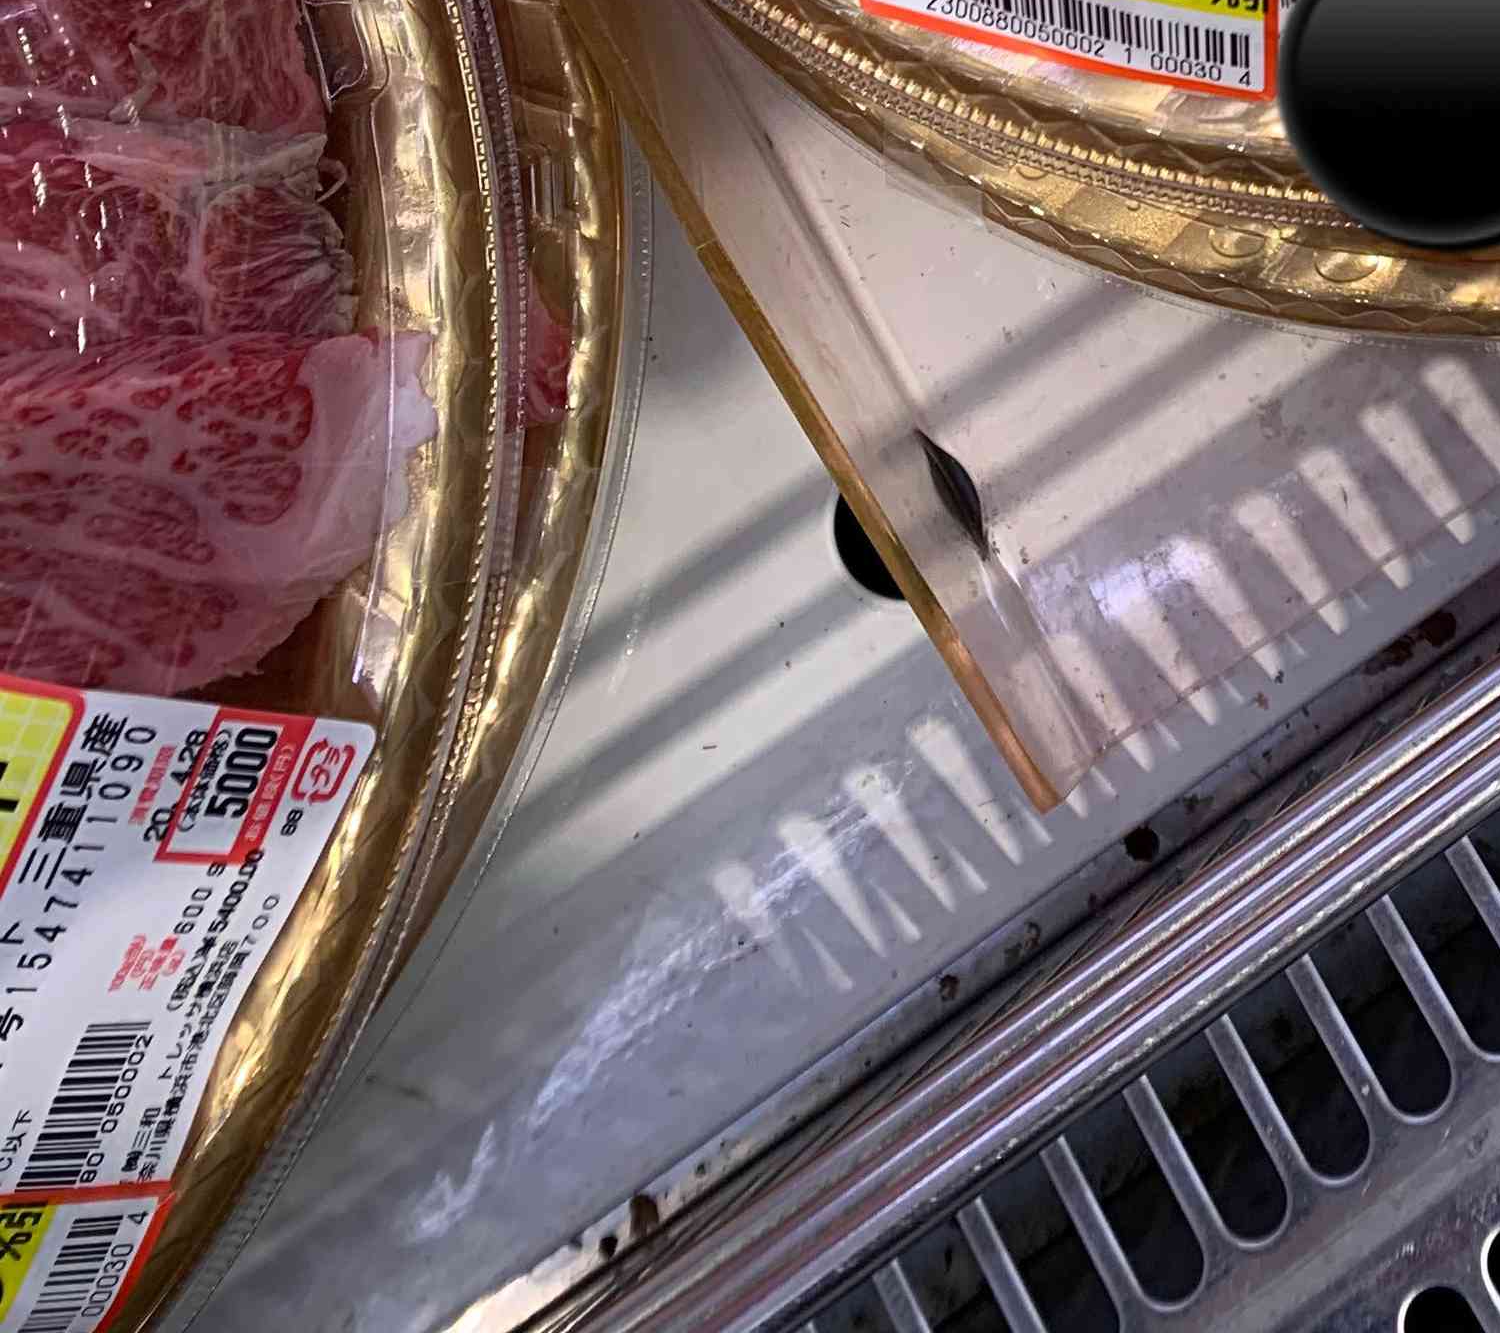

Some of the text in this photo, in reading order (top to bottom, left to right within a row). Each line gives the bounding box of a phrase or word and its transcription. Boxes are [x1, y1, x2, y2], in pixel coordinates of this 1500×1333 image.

[1150, 53, 1222, 83] 00030
[19, 711, 128, 891] 三重県産
[204, 727, 279, 819] 5000
[174, 887, 213, 935] 600
